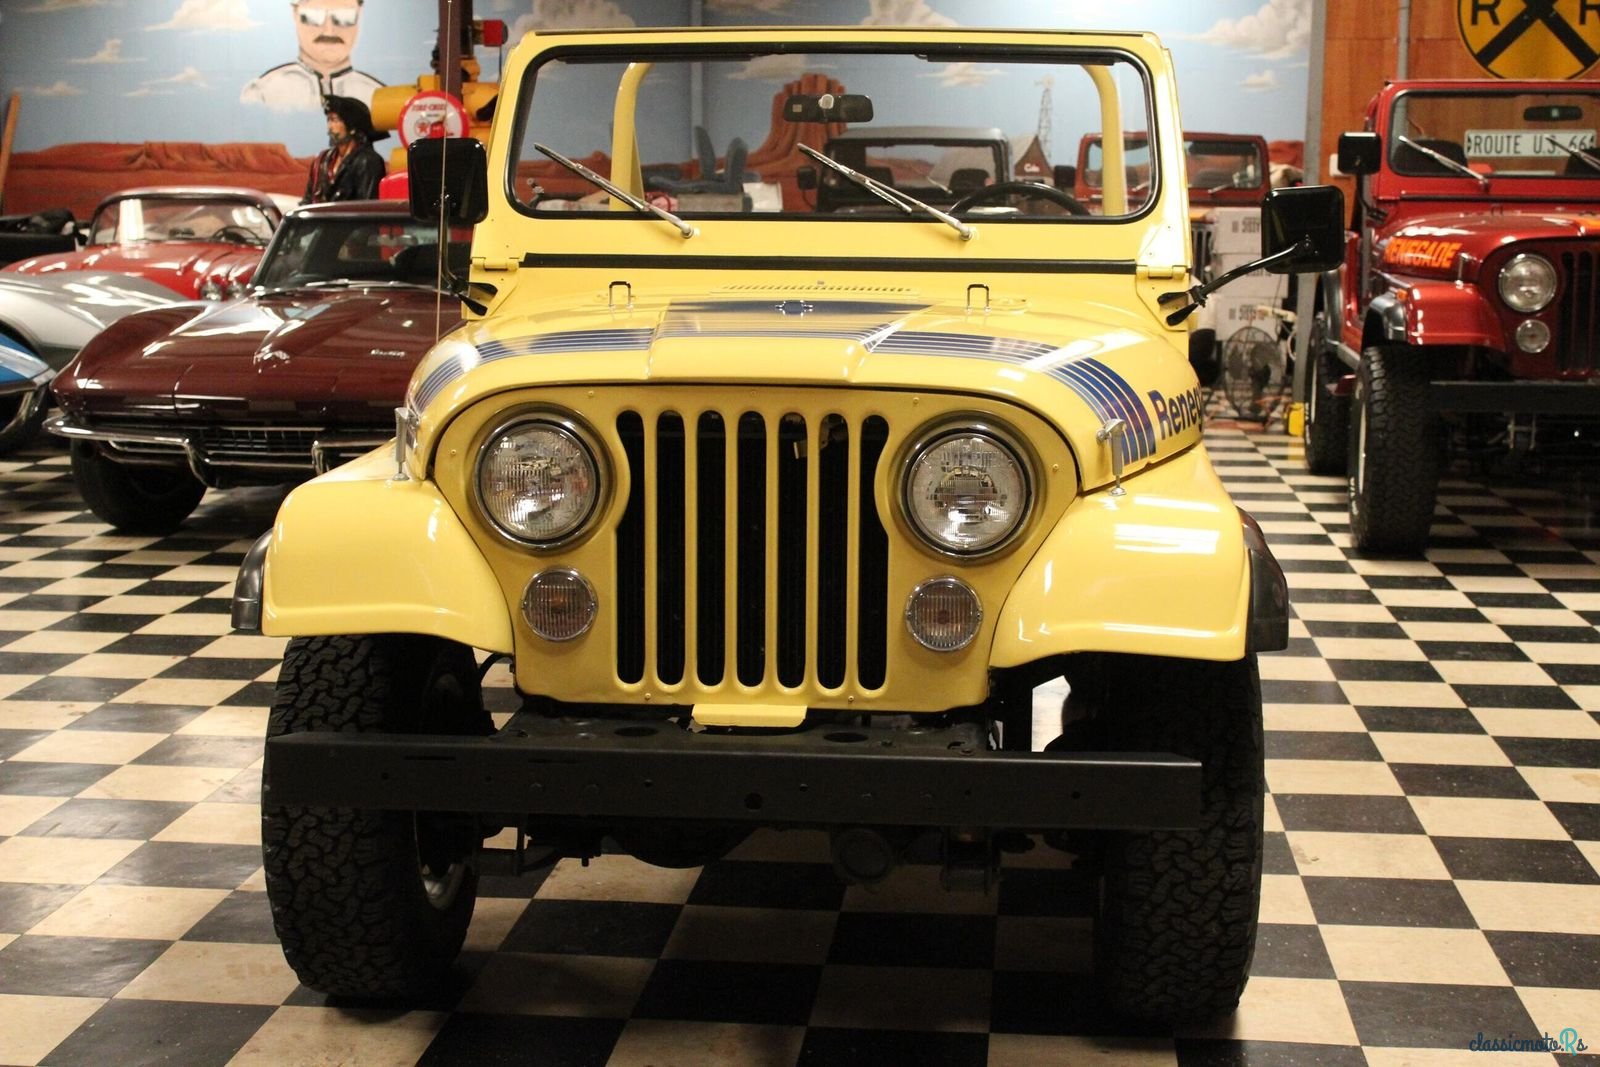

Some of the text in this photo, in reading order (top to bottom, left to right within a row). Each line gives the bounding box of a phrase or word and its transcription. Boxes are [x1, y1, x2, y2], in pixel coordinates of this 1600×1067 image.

[1473, 134, 1523, 155] ROUTE
[1568, 134, 1588, 153] 66
[1384, 237, 1463, 269] RENEGADE
